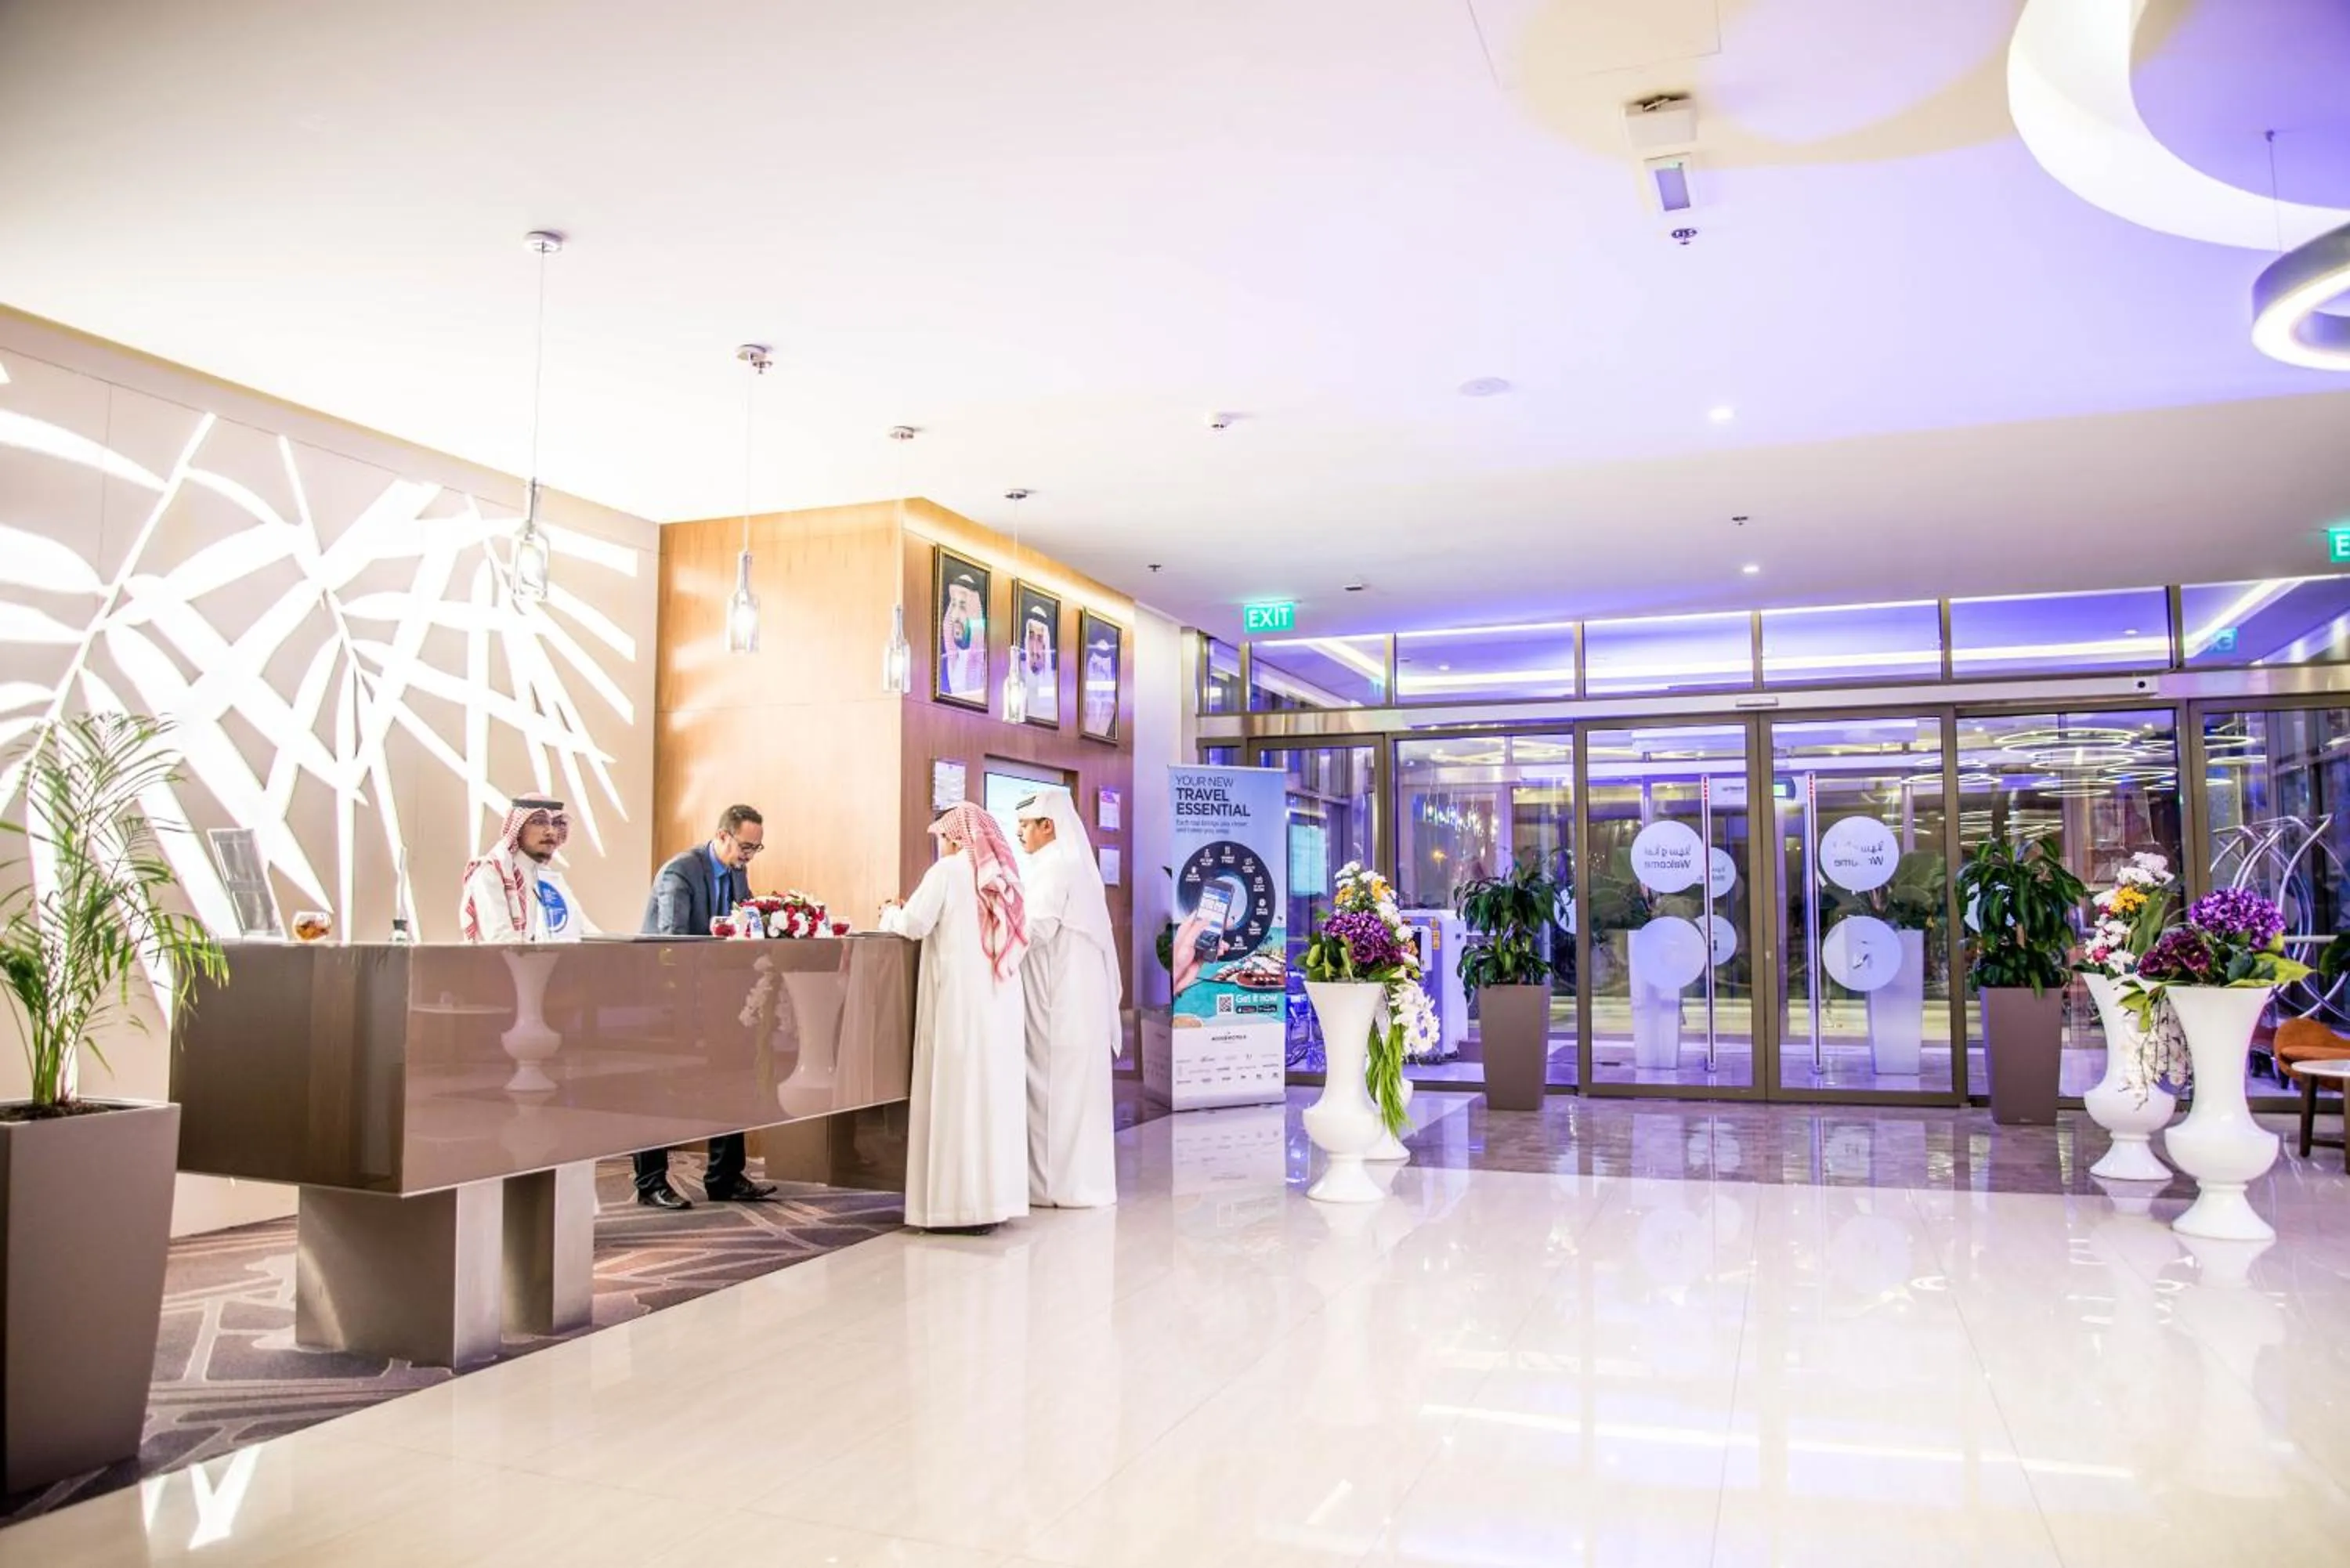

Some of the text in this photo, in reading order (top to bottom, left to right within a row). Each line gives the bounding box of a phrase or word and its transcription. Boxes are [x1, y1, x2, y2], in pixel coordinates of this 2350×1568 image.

[1248, 607, 1291, 627] EXIT
[1176, 775, 1234, 788] YOUR NEW
[1176, 787, 1230, 802] TRAVEL
[1177, 802, 1251, 817] ESSENTIAL
